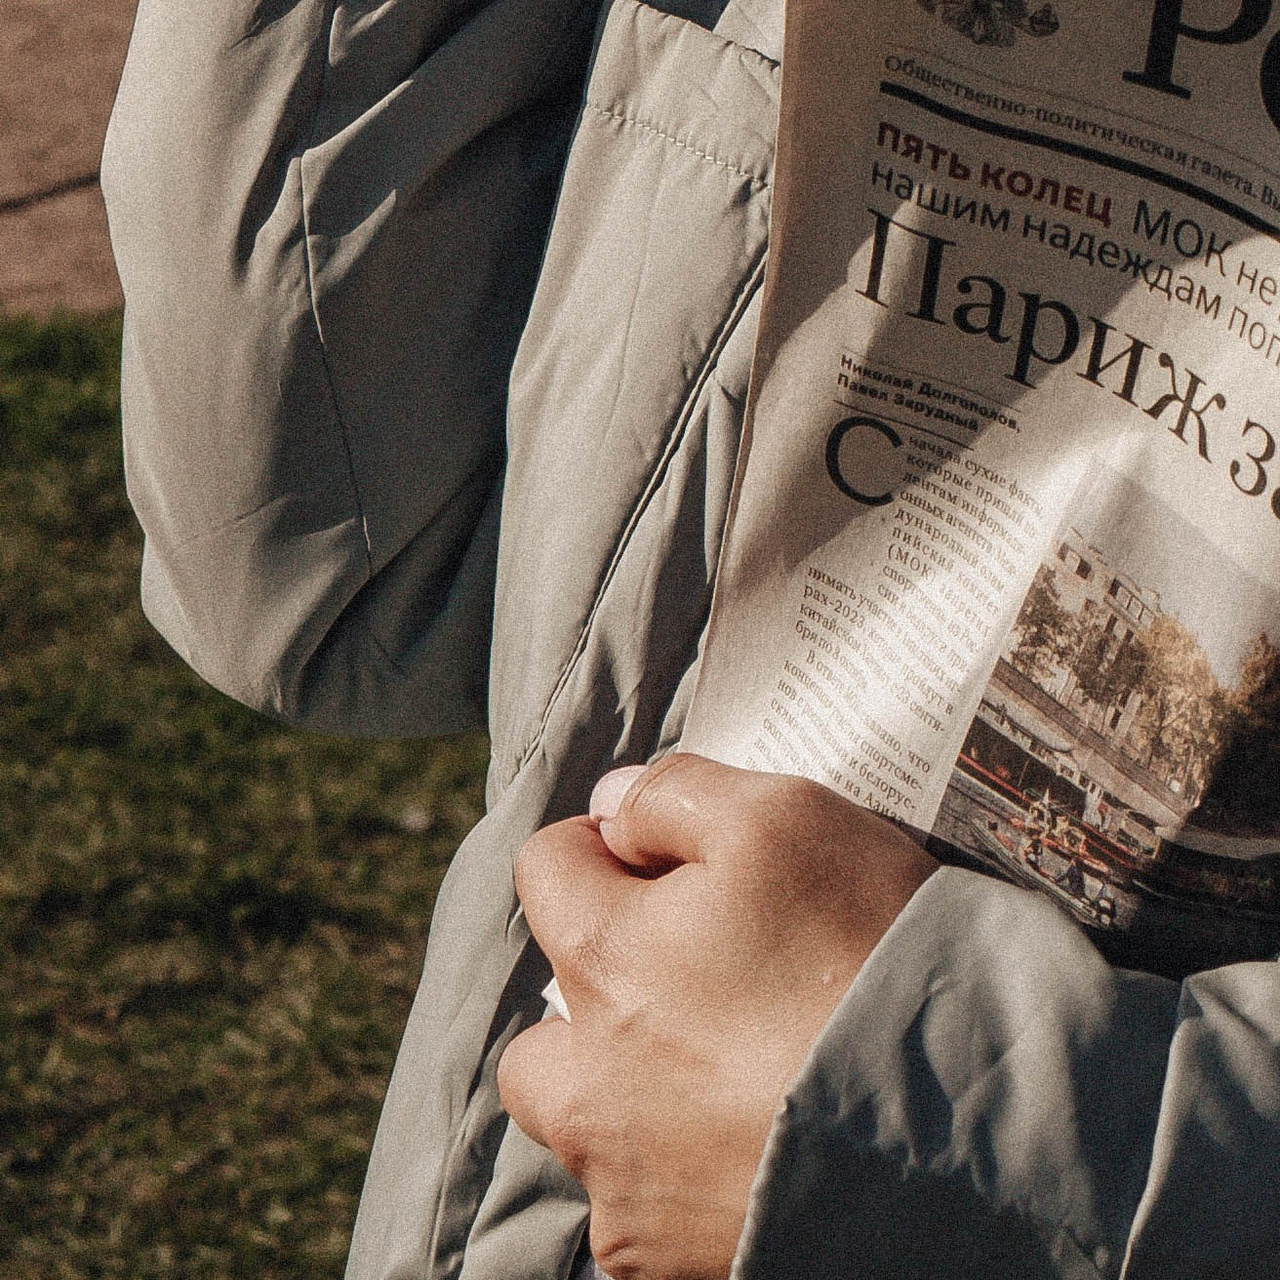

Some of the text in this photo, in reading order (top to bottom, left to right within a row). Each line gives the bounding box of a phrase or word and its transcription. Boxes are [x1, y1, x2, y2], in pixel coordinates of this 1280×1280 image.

[883, 53, 1189, 166] Общественно-политическая
[1190, 153, 1258, 203] газета.
[871, 160, 1011, 234] нашим
[1021, 213, 1223, 321] надеждам
[878, 120, 973, 183] ПЯТЬ
[977, 157, 1114, 228] КОЛЕЦ
[1131, 198, 1235, 280] МОК
[1237, 259, 1279, 307] не
[854, 207, 1231, 463] Париж
[837, 372, 979, 432] Павел Зарудный
[841, 354, 1021, 434] Николай Долгополов,
[906, 454, 972, 490] которые
[964, 458, 1008, 488] сухие
[892, 527, 954, 573] пийский
[858, 763, 915, 809] белорус-
[907, 750, 933, 774] что
